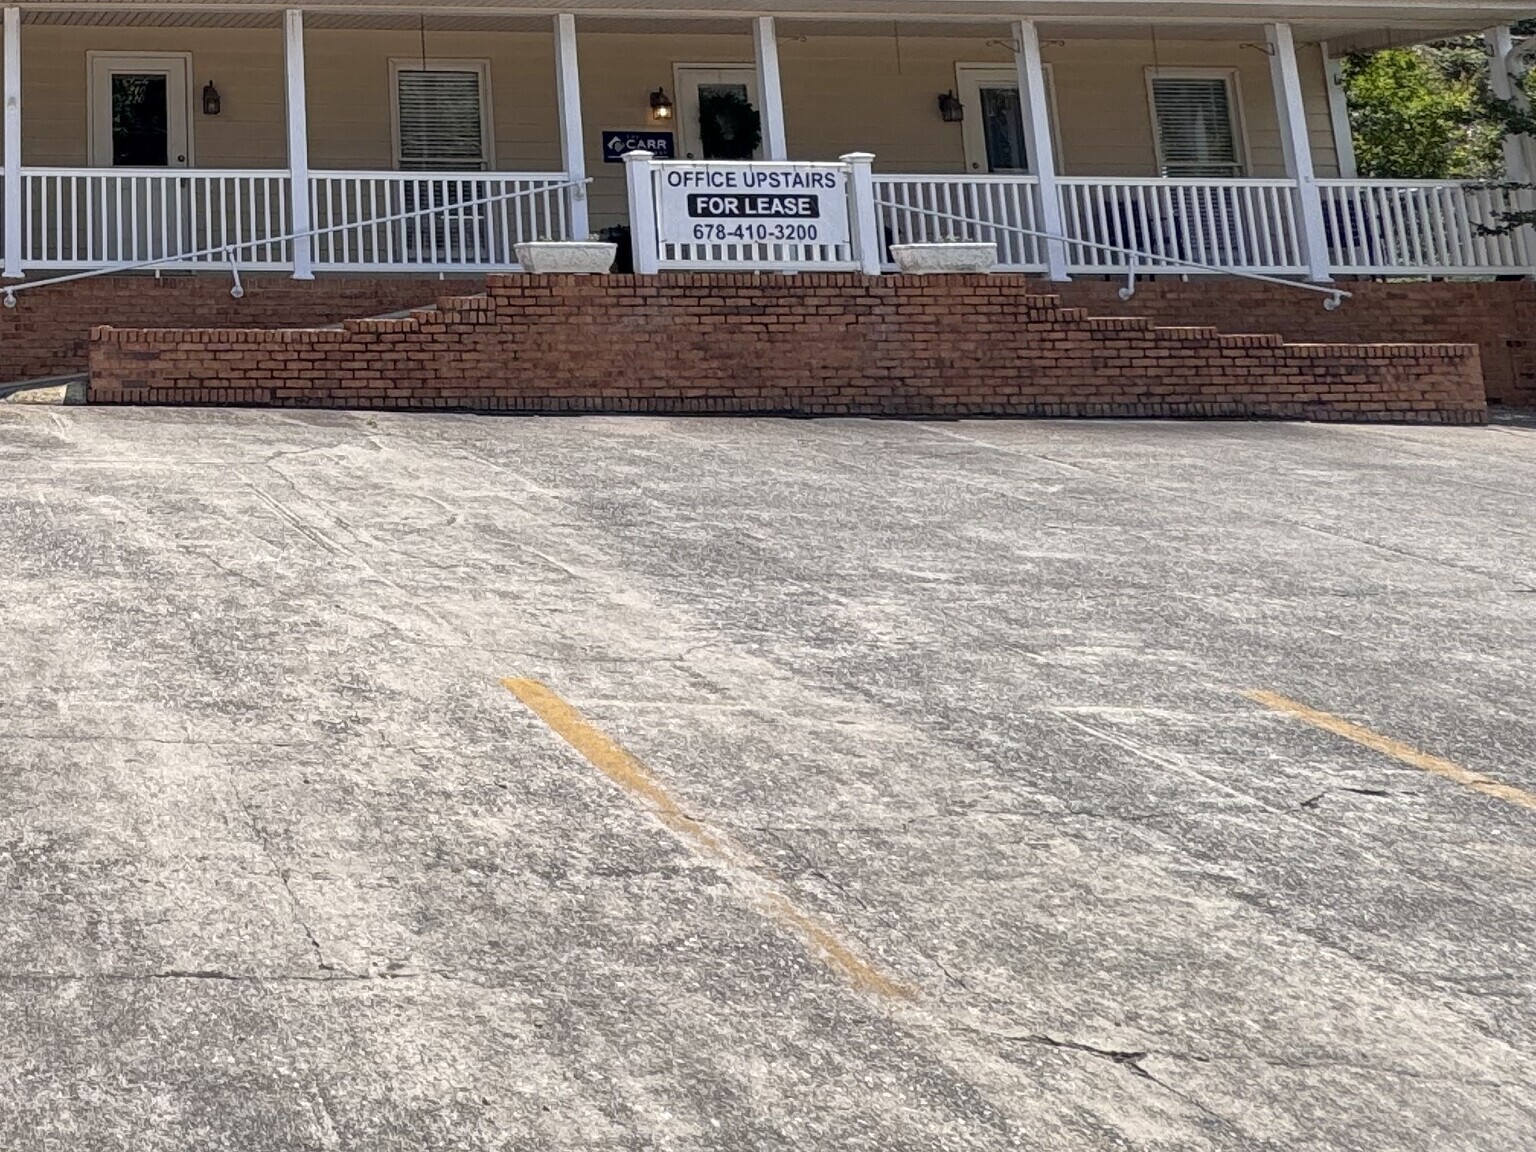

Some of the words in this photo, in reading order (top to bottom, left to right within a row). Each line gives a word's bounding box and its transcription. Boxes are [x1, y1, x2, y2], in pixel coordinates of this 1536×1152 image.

[625, 138, 667, 150] CARR
[667, 170, 738, 188] OFFICE
[743, 171, 837, 189] UPSTAIRS
[695, 196, 740, 215] FOR
[744, 197, 812, 216] LEASE
[692, 223, 818, 241] 678-410-3200
